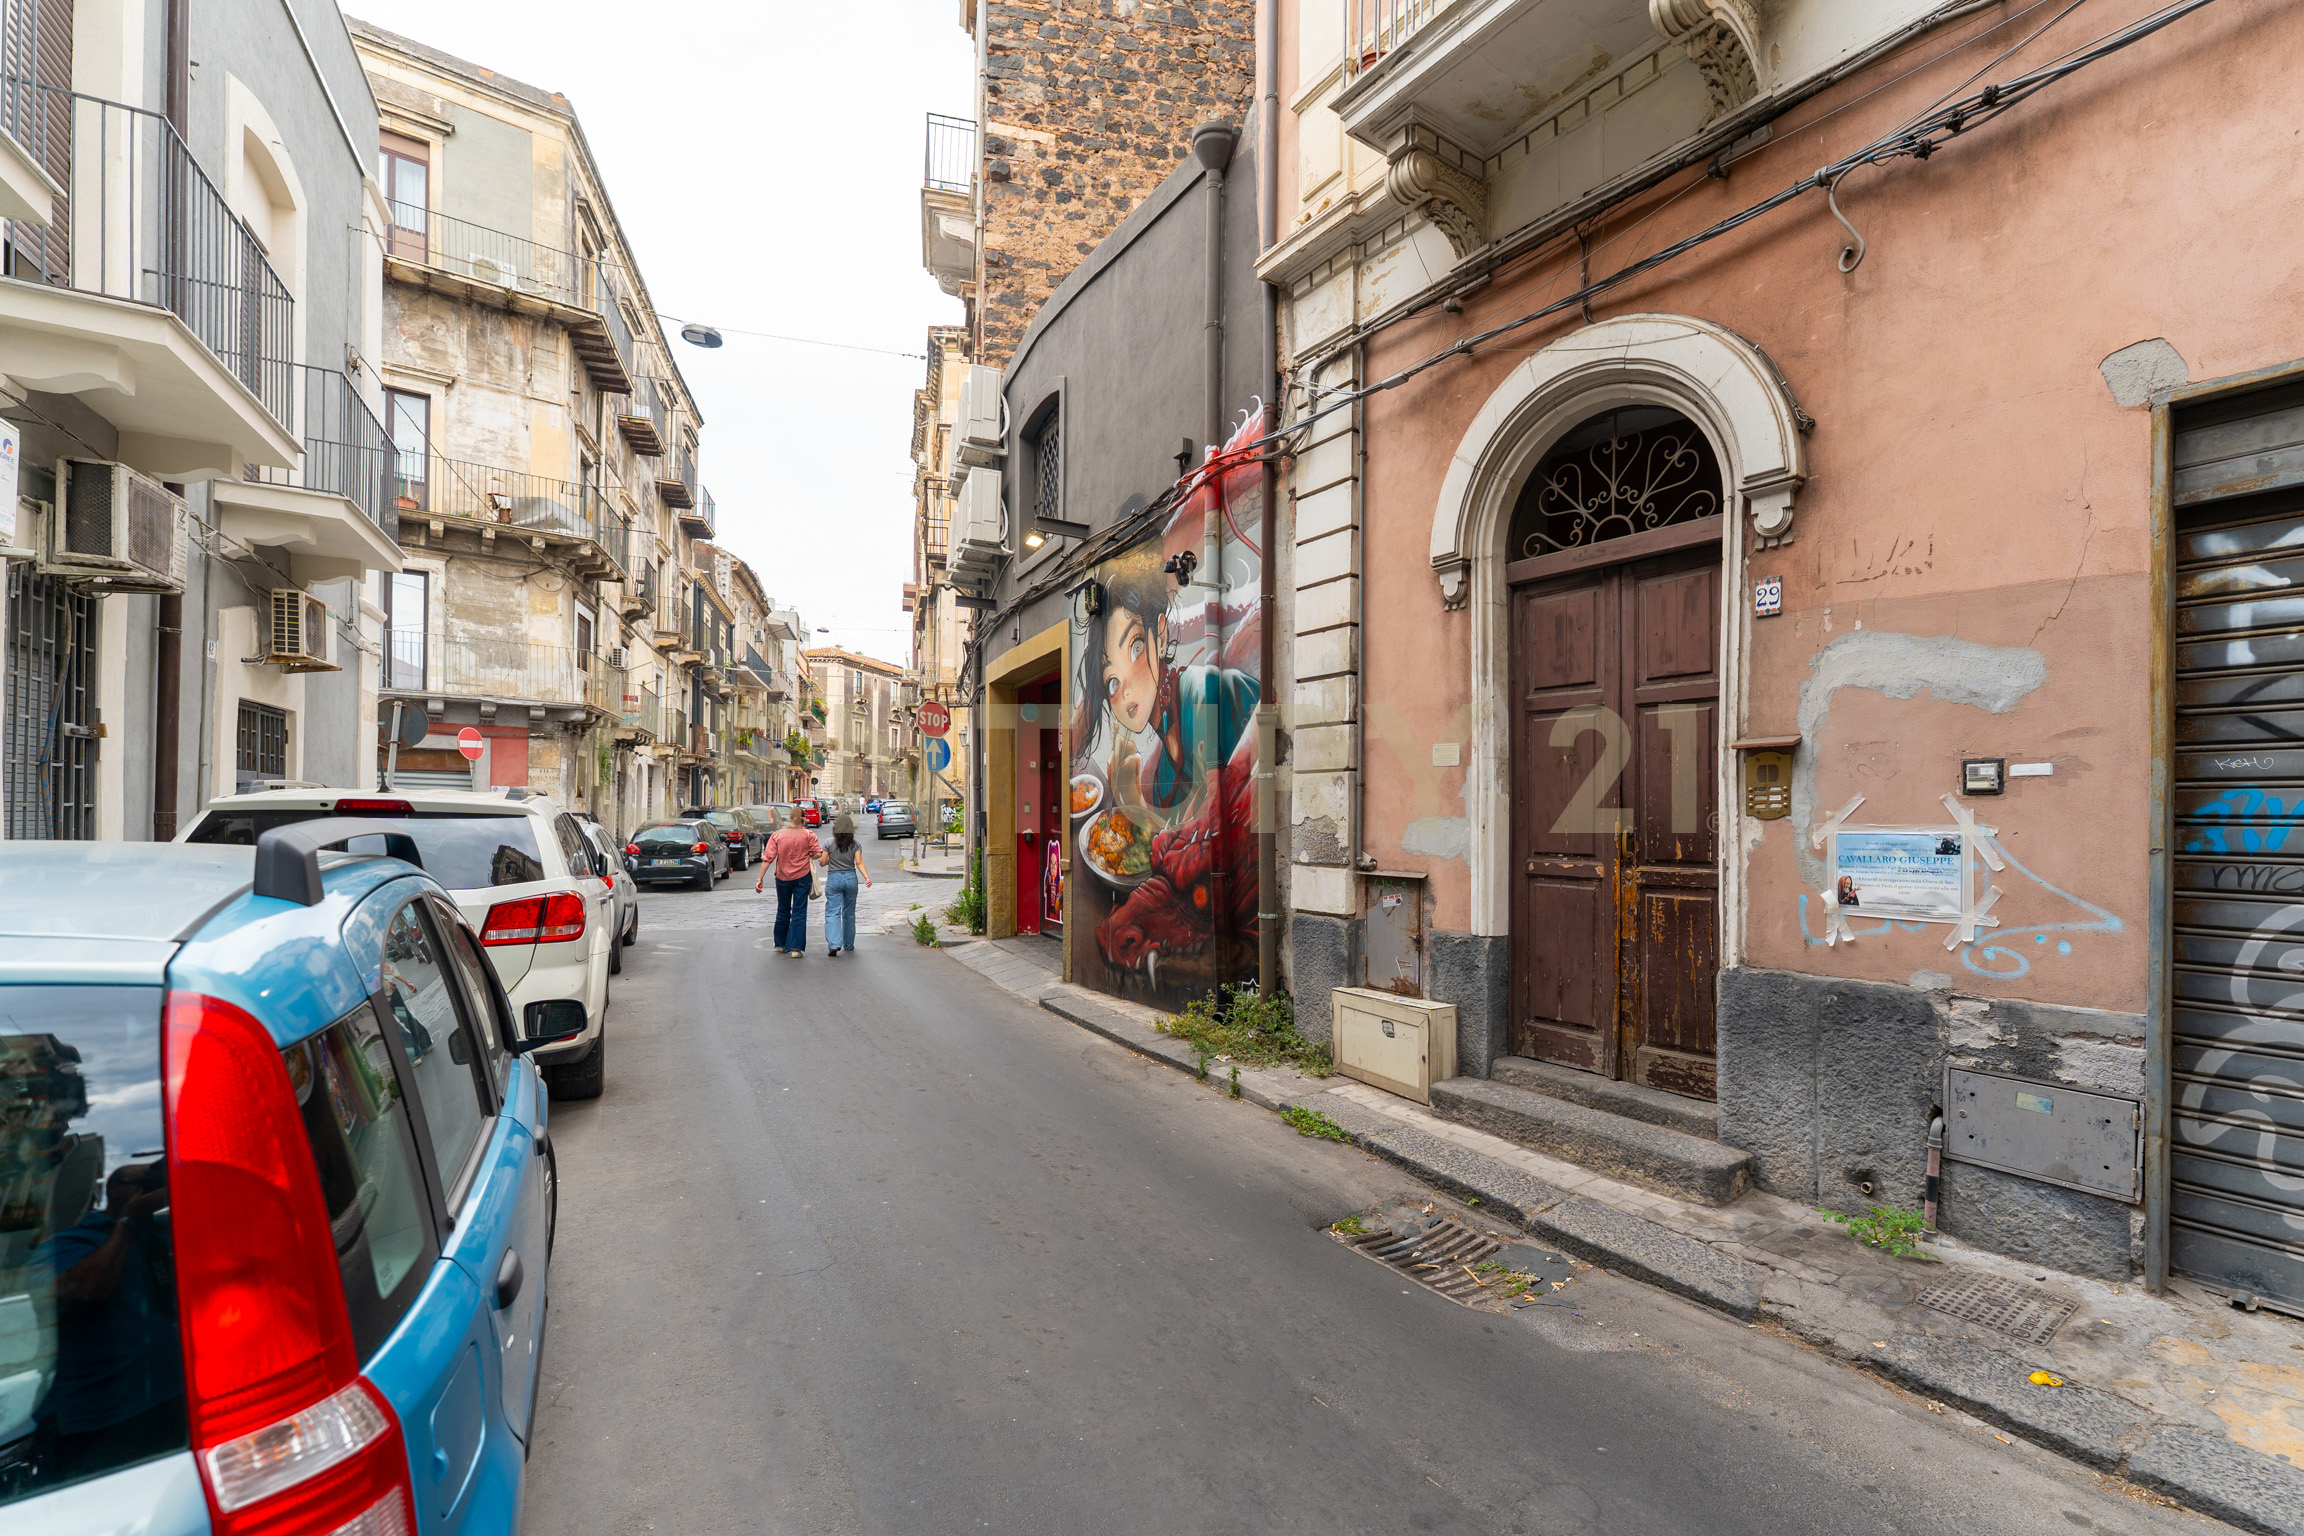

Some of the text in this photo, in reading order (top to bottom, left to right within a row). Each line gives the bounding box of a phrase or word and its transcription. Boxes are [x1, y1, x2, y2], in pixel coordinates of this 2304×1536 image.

[1757, 586, 1779, 607] 29
[919, 711, 948, 728] STOP
[1838, 855, 1954, 865] CAVALLARO GIUSEPPE
